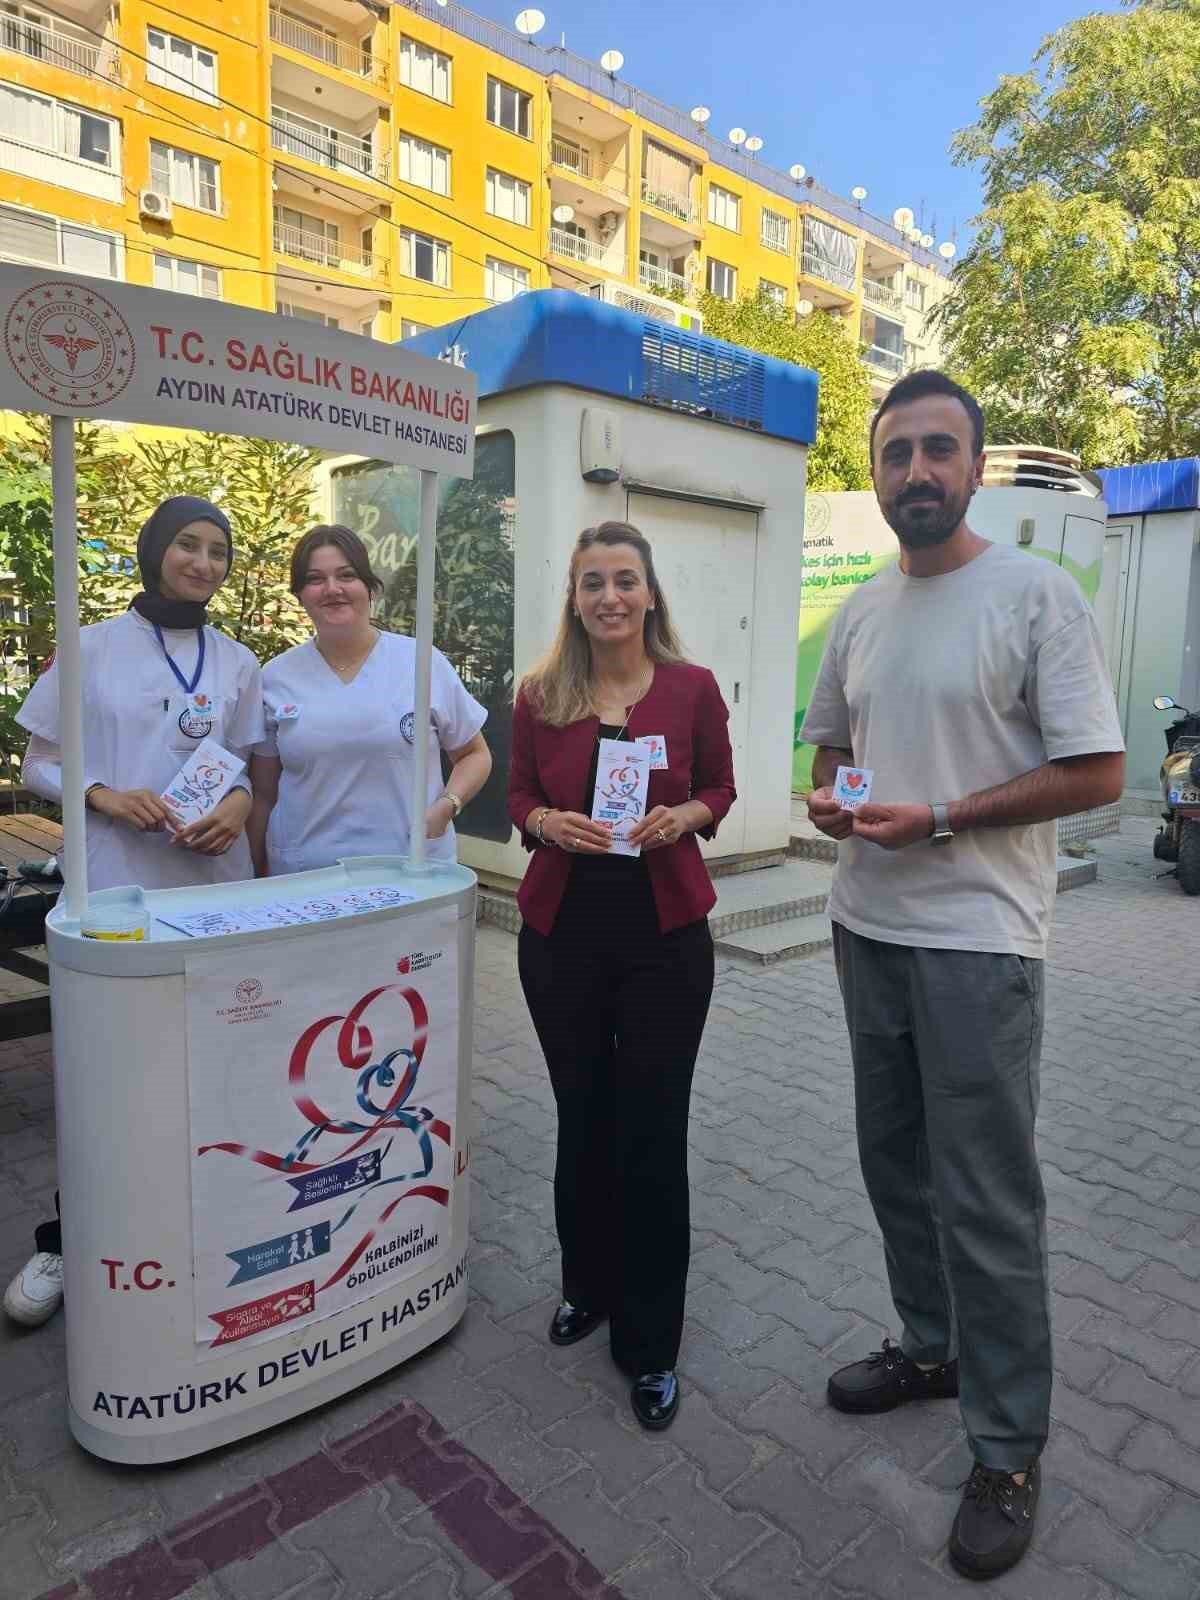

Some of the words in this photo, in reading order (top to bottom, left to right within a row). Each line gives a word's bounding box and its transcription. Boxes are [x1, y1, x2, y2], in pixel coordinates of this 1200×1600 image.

[150, 324, 215, 367] T.C.
[226, 339, 342, 391] SAĞLIK
[350, 366, 470, 425] BAKANLIĞI
[156, 376, 226, 406] AYDIN
[231, 387, 324, 422] ATATÜRK
[328, 405, 392, 437] DEVLET
[395, 420, 468, 455] HASTANESİ
[100, 1258, 176, 1291] T.C.
[346, 1234, 439, 1289] ÖDÜLLENDİRİN!
[365, 1223, 425, 1264] KALBİNİZİ
[92, 1371, 248, 1420] ATATÜRK
[257, 1317, 379, 1389] DEVLET
